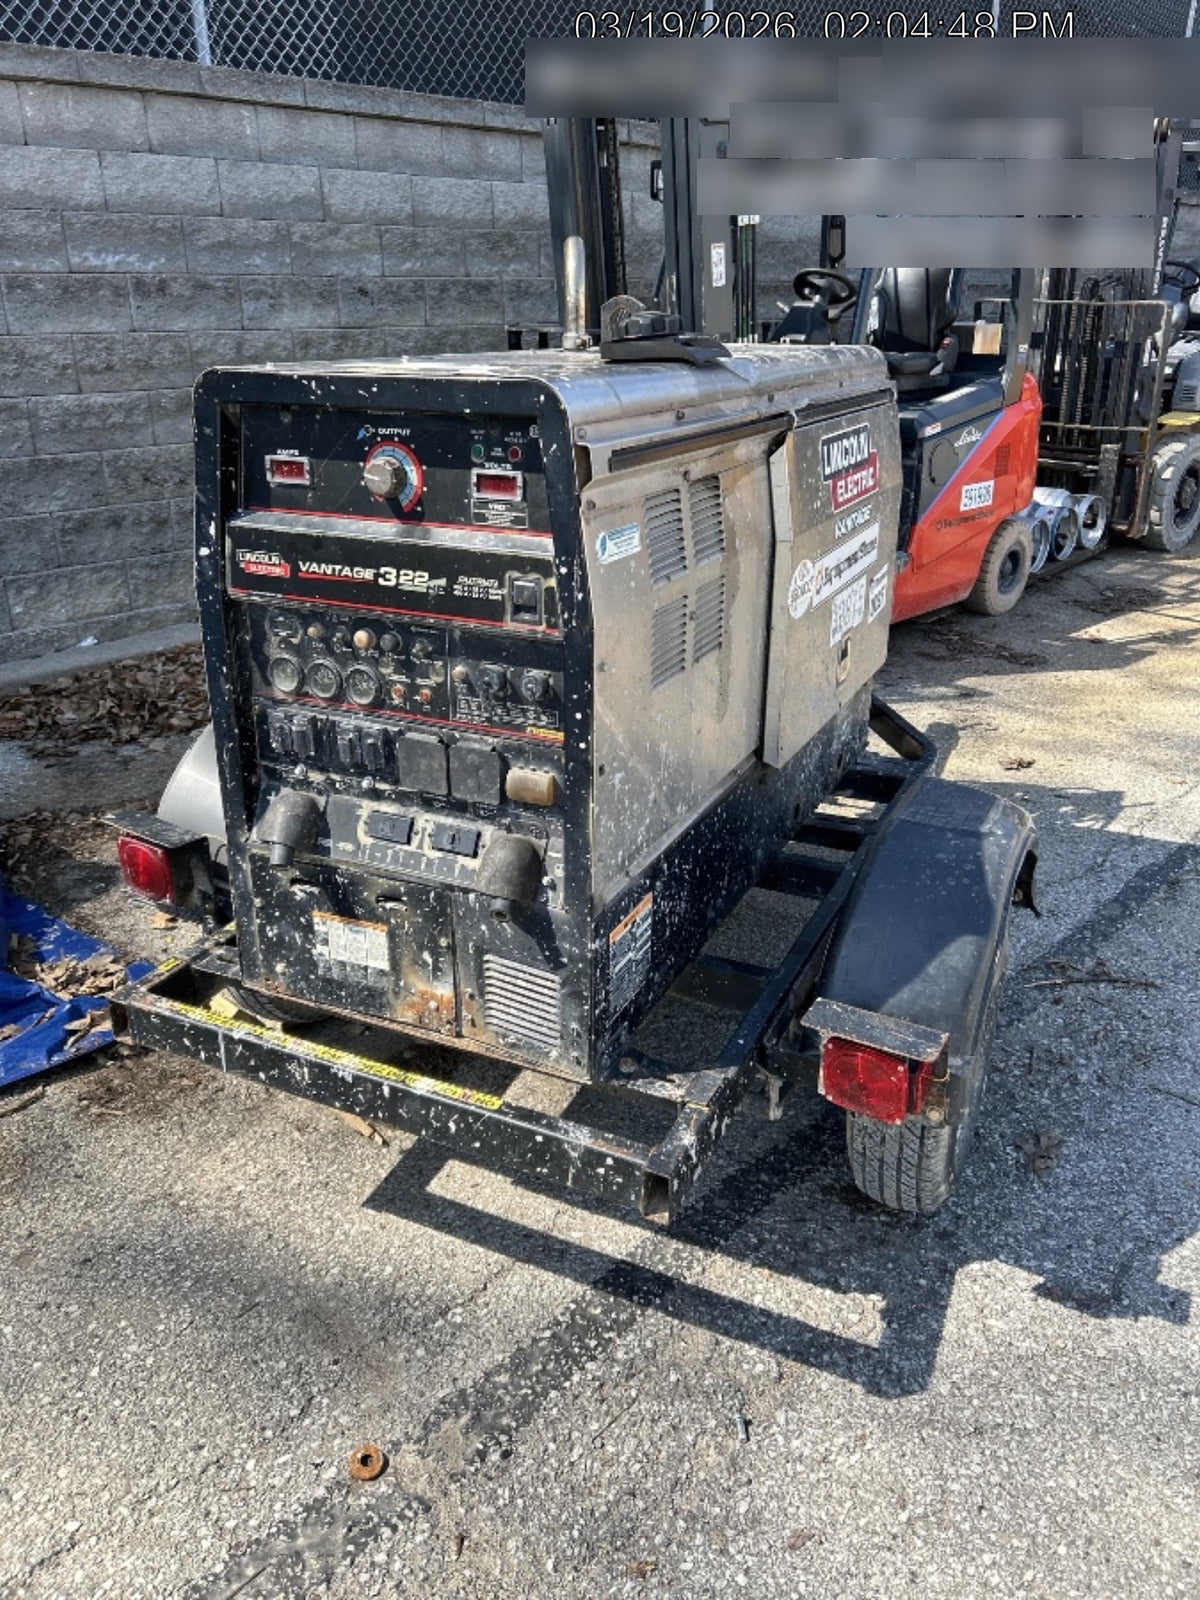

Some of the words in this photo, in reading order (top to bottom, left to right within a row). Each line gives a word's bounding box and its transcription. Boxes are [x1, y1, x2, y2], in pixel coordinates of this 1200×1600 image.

[378, 428, 410, 437] OUTPUT
[823, 431, 869, 475] LINCOLN
[837, 467, 874, 502] ELECTRIC
[238, 552, 281, 565] LINCOLN
[298, 561, 374, 580] VANTAGE
[378, 566, 430, 587] 322
